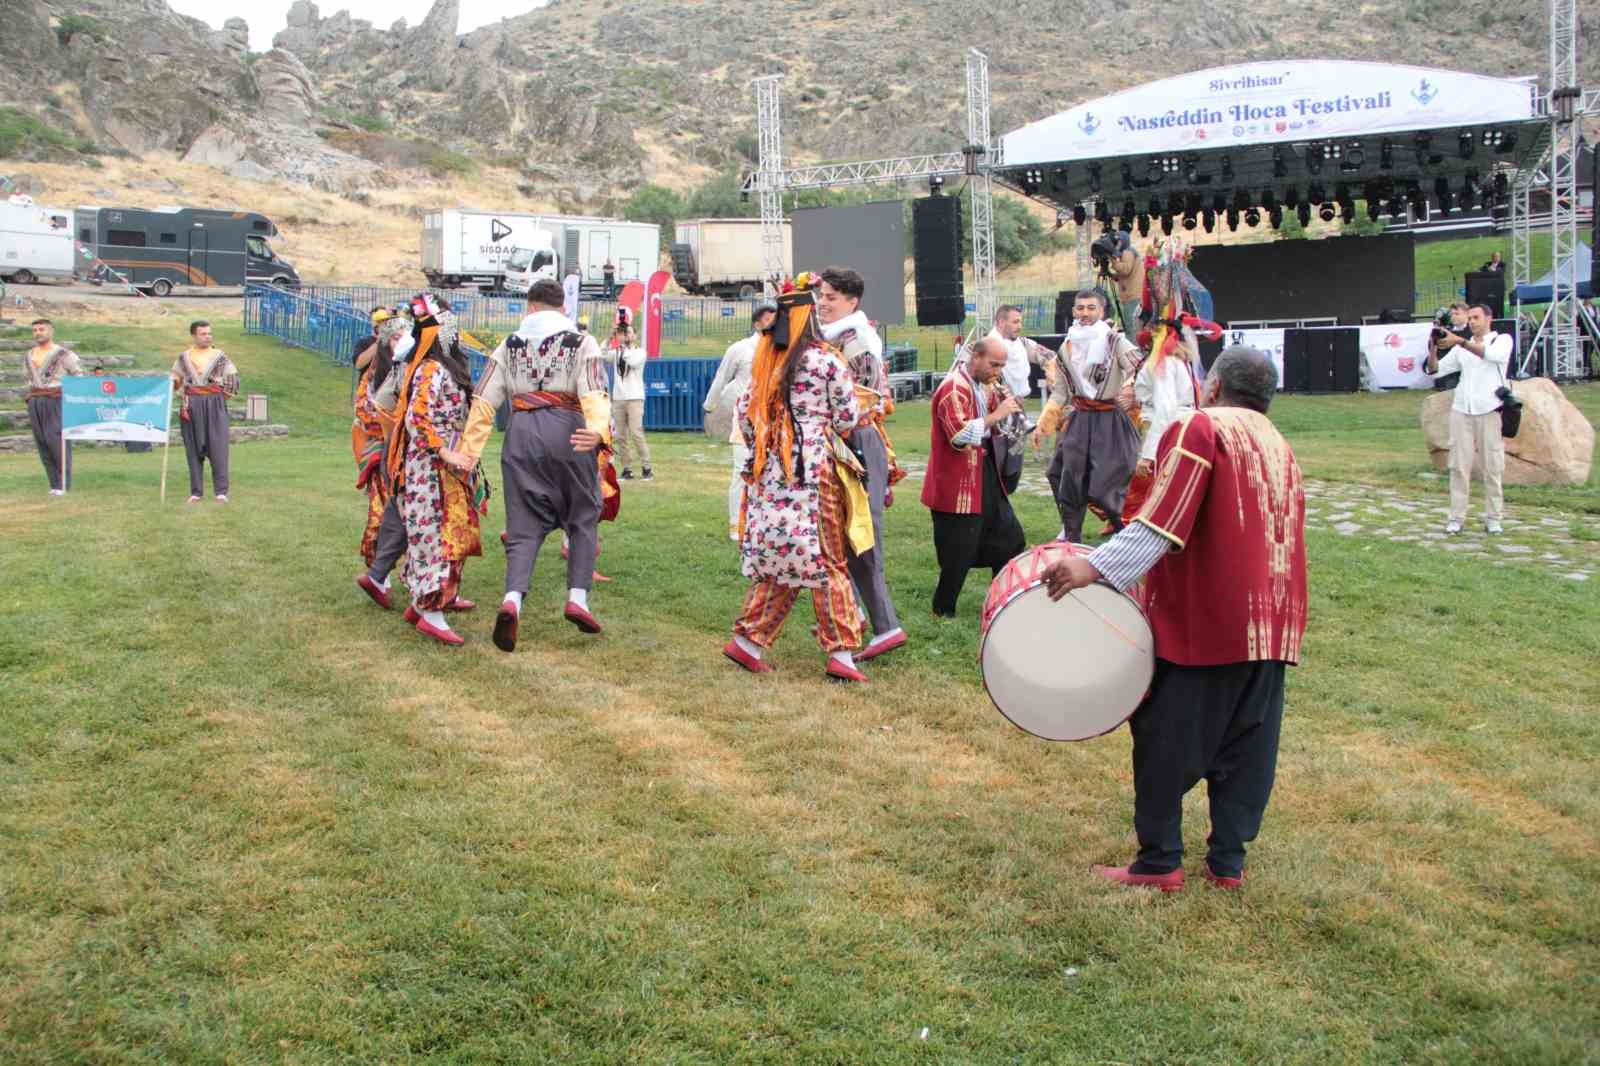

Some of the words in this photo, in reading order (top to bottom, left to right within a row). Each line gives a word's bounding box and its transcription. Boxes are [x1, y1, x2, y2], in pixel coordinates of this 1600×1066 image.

[1208, 71, 1290, 91] Sivrihisar
[1228, 104, 1288, 121] Hoca
[1293, 91, 1392, 115] Festivali
